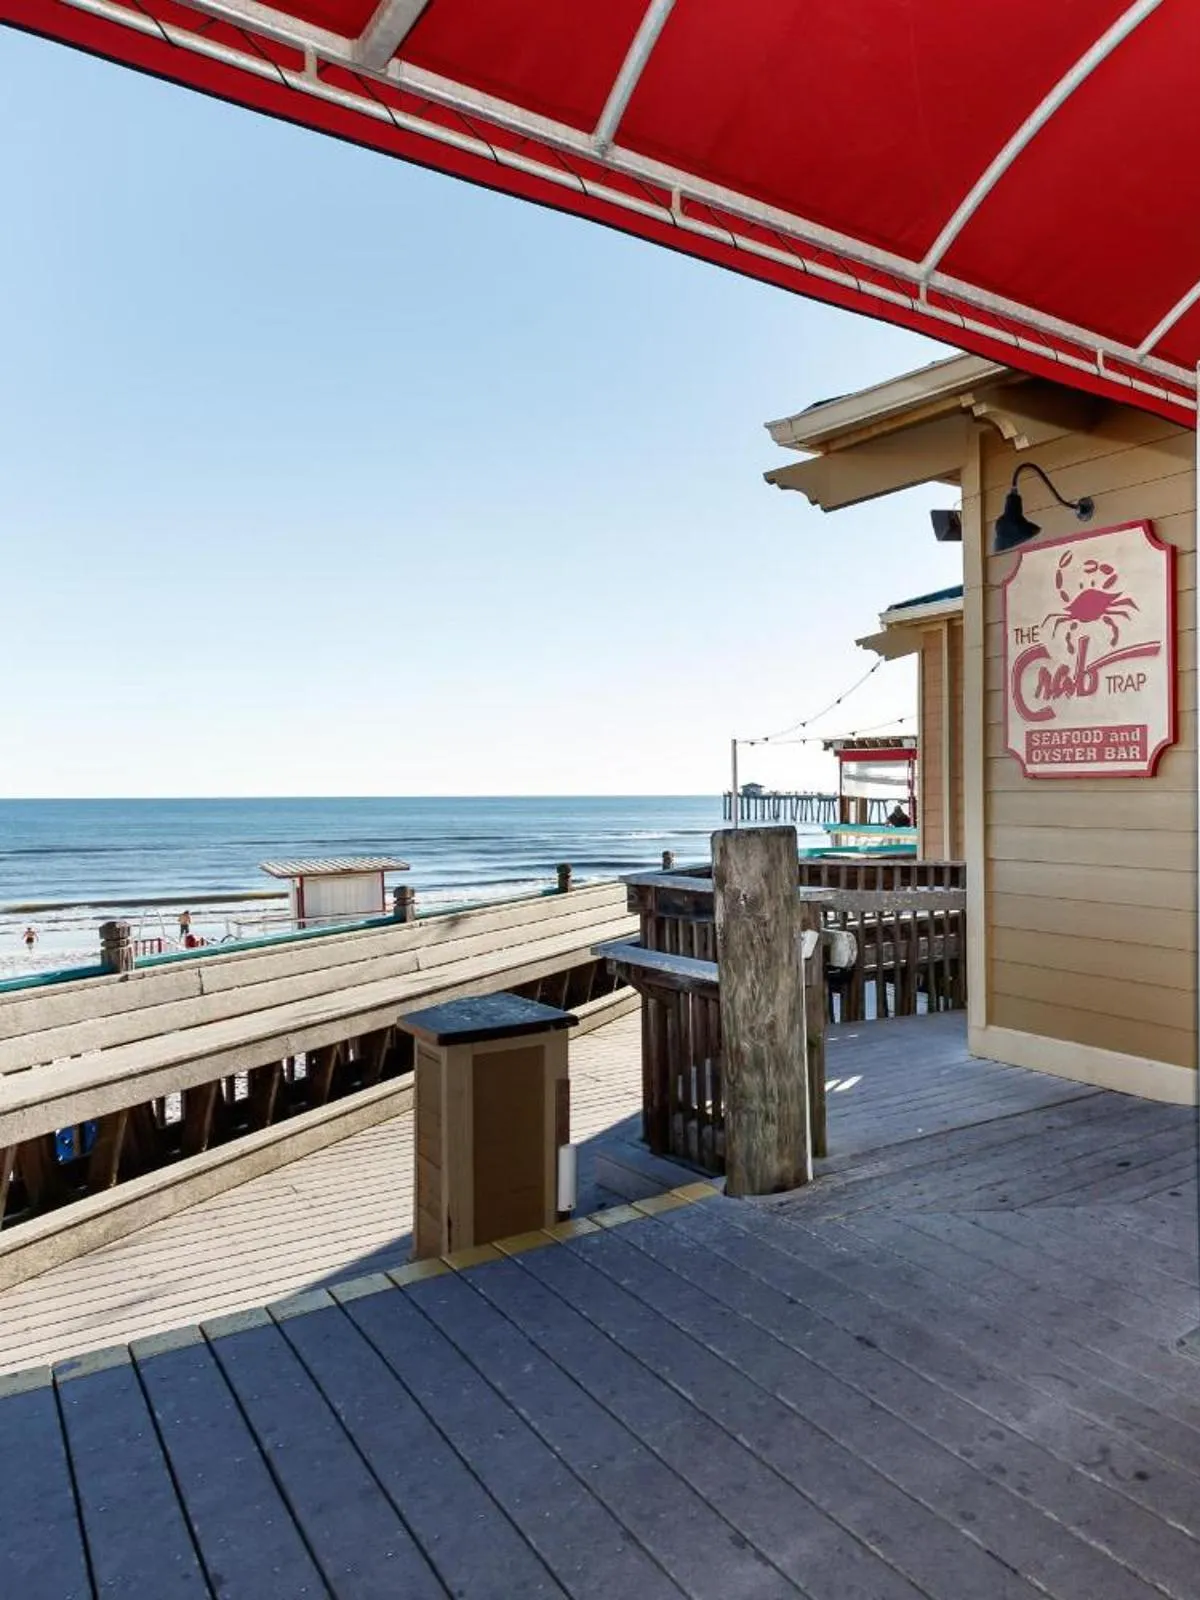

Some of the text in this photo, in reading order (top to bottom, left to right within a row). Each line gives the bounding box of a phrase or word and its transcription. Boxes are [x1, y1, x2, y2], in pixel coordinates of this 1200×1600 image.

[1014, 625, 1040, 645] THE
[1012, 635, 1161, 722] Crab TRAP
[1031, 728, 1141, 746] SEAFOOD and
[1031, 746, 1141, 762] OYSTER BAR
